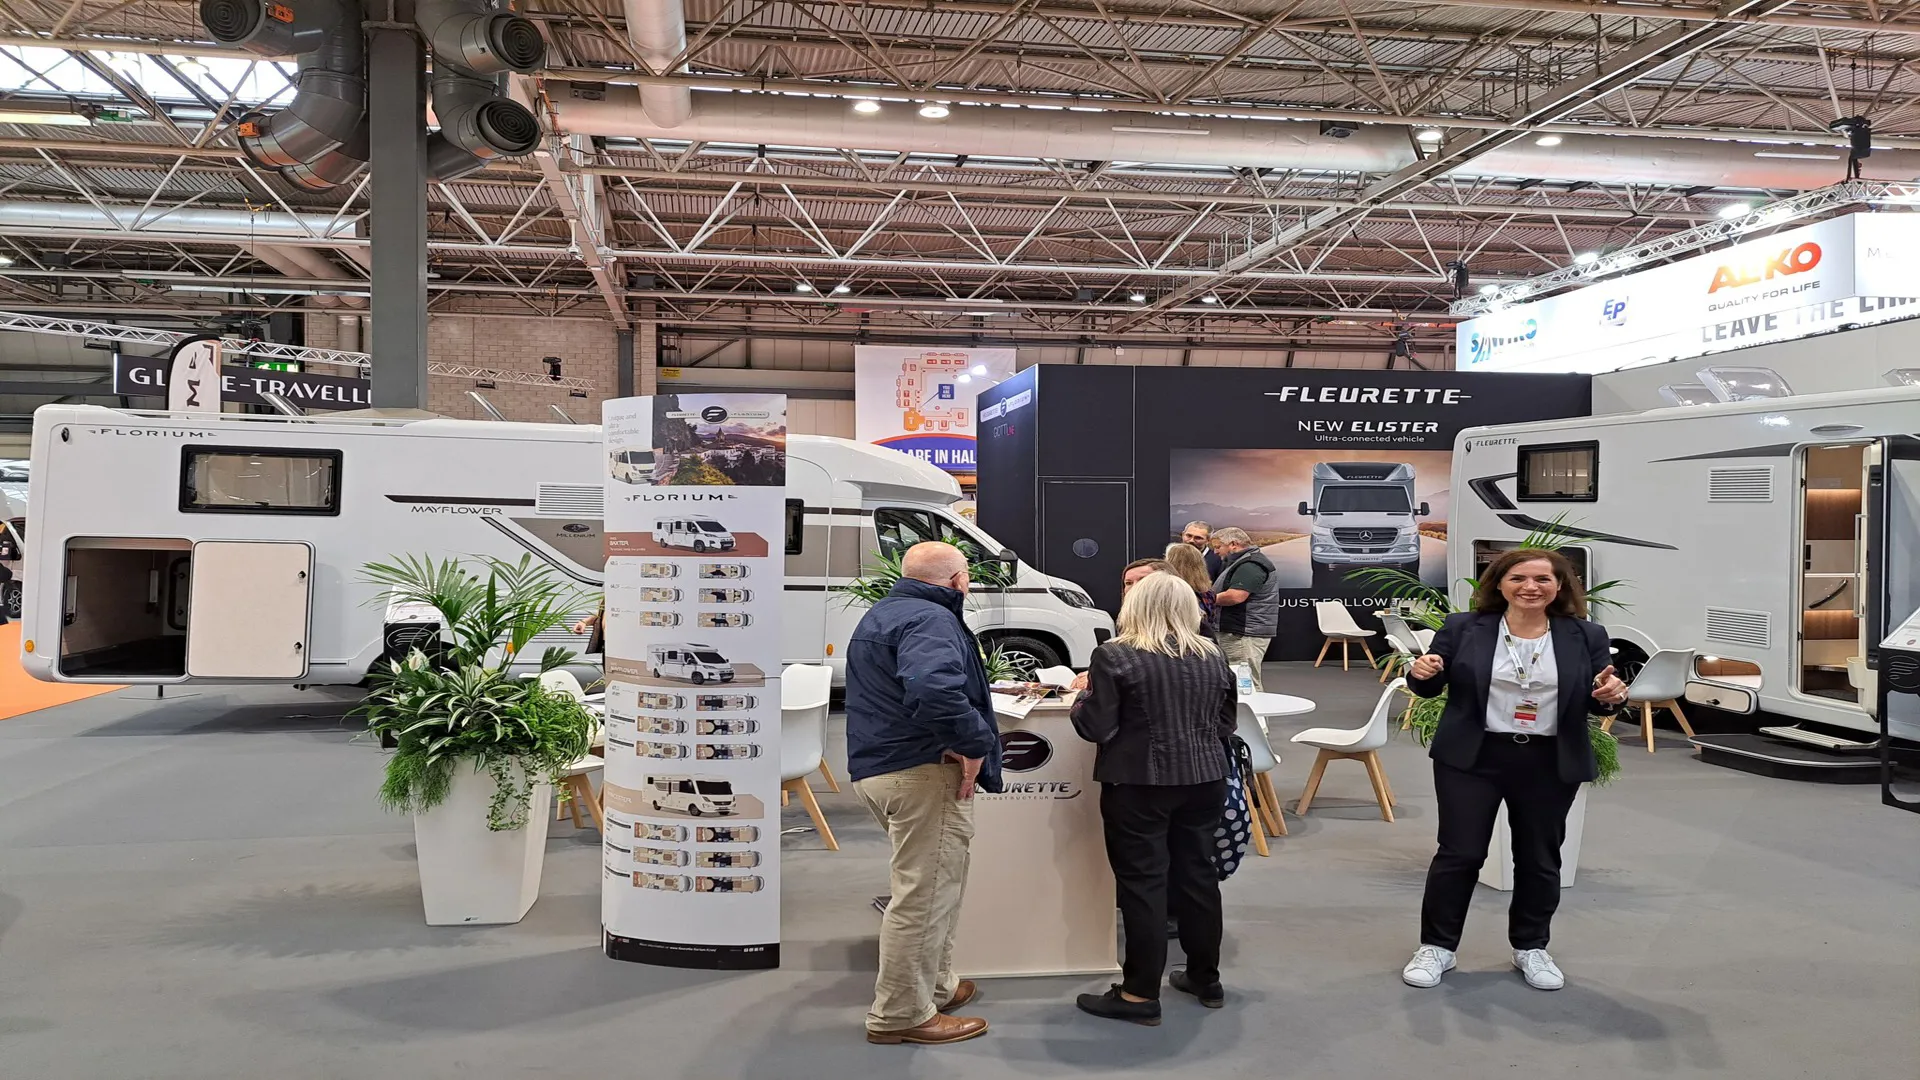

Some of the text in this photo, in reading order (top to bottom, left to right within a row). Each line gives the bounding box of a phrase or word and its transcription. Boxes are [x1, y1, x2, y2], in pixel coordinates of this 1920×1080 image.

[1708, 280, 1821, 312] QUALITY FOR LIFE
[1701, 313, 1778, 343] LEAVE
[129, 367, 371, 404] GLE-TRAVELL
[1279, 386, 1461, 405] FLEURETTE
[1298, 420, 1438, 433] NEW ELISTER
[101, 428, 206, 438] FLORIUM
[1315, 434, 1425, 443] Ultra-connected vehicle
[1476, 437, 1517, 447] FLEURETTE
[935, 449, 949, 464] IN
[632, 494, 724, 502] FLORIUM
[411, 505, 503, 515] MAYFLOWER
[1278, 598, 1319, 608] JUST
